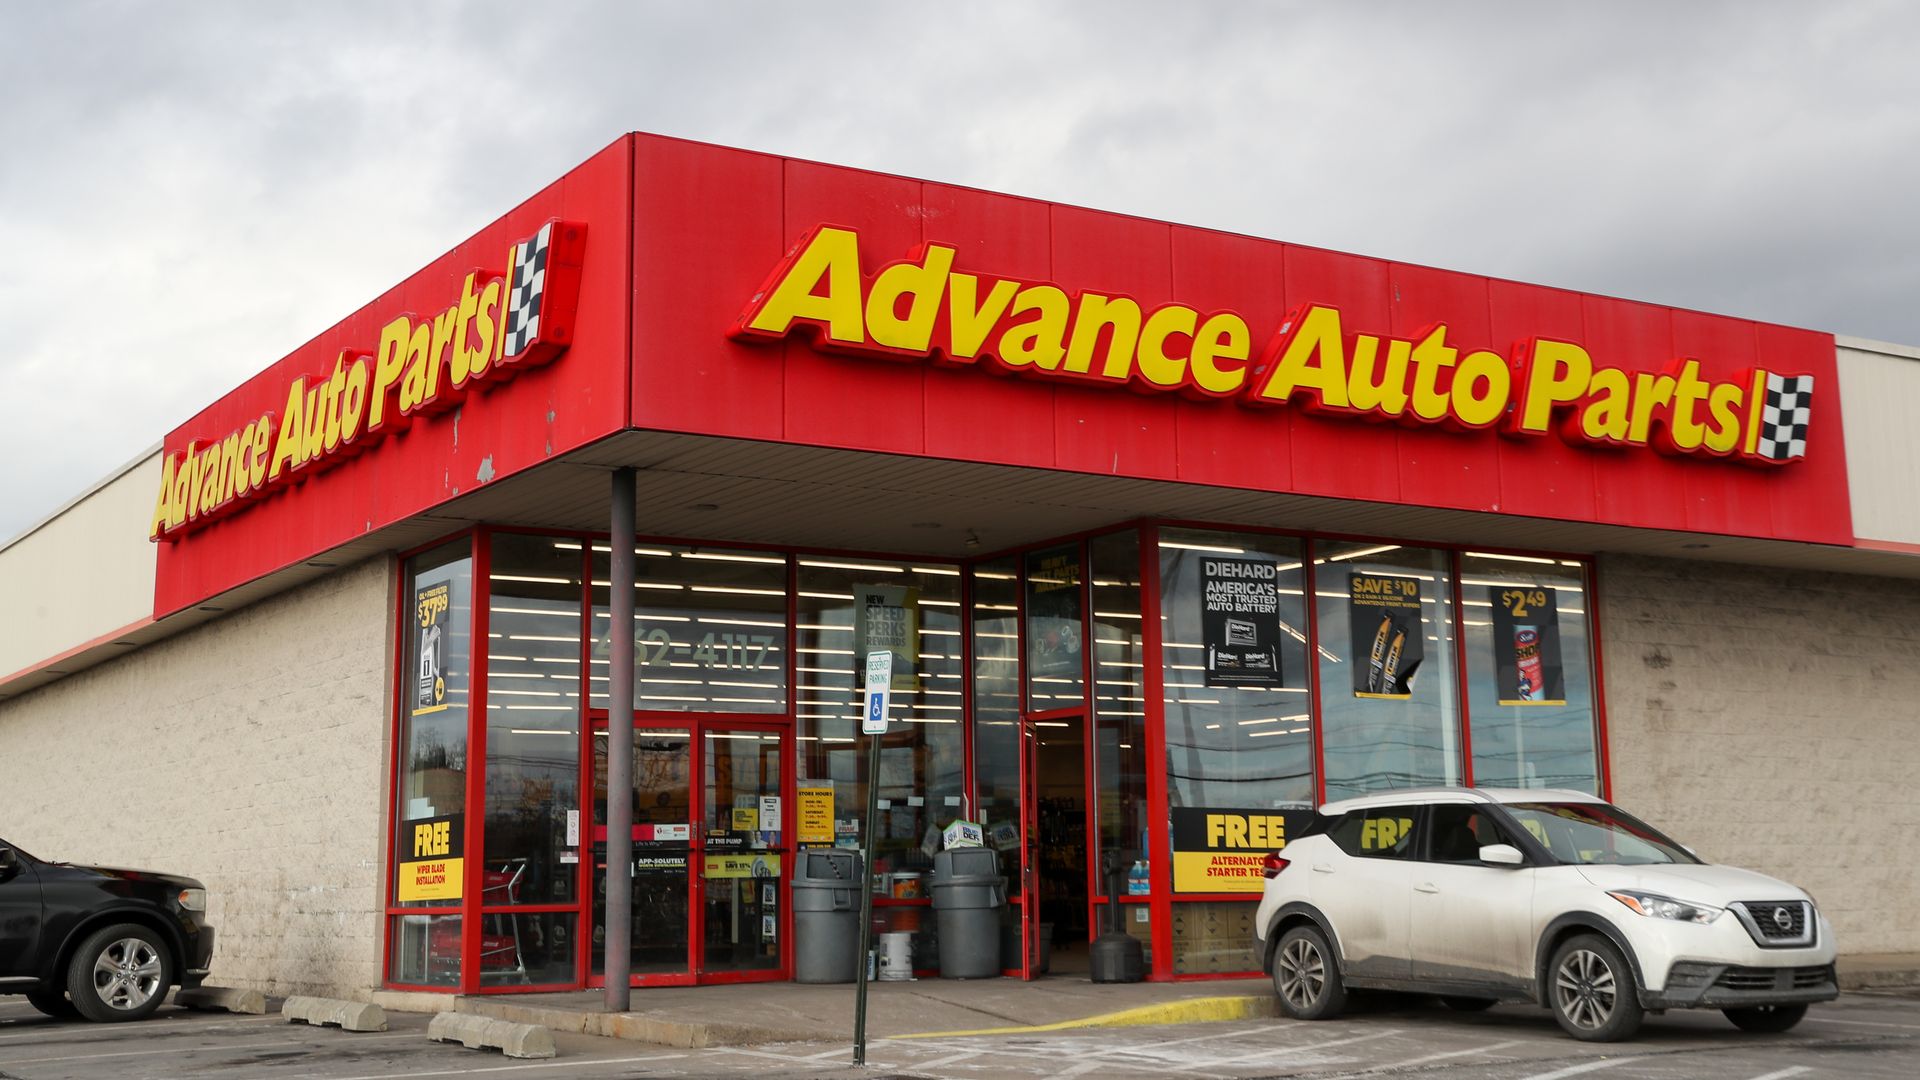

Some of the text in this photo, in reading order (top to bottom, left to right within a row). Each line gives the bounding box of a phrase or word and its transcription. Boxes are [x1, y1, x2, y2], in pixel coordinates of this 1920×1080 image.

[748, 227, 1745, 453] Advance Auto Parts
[149, 272, 500, 538] Advance Auto Parts
[1205, 561, 1276, 580] DIEHARD
[1206, 580, 1276, 596] AMERICA'S
[1352, 576, 1417, 597] SAVE $10
[865, 594, 885, 604] NEW
[1206, 592, 1277, 605] MOST TRUSTED
[866, 605, 906, 621] SPEED
[1207, 602, 1277, 614] AUTO BATTERY
[866, 621, 906, 637] PERKS
[866, 637, 906, 647] REWARDS
[869, 674, 888, 684] PARKING
[1206, 814, 1286, 849] FREE
[414, 821, 450, 857] FREE
[1211, 855, 1264, 866] ALTERNATO
[417, 864, 445, 874] WIPER BLADE
[1207, 867, 1264, 877] STARTER TES
[416, 875, 445, 885] INSTALLATION
